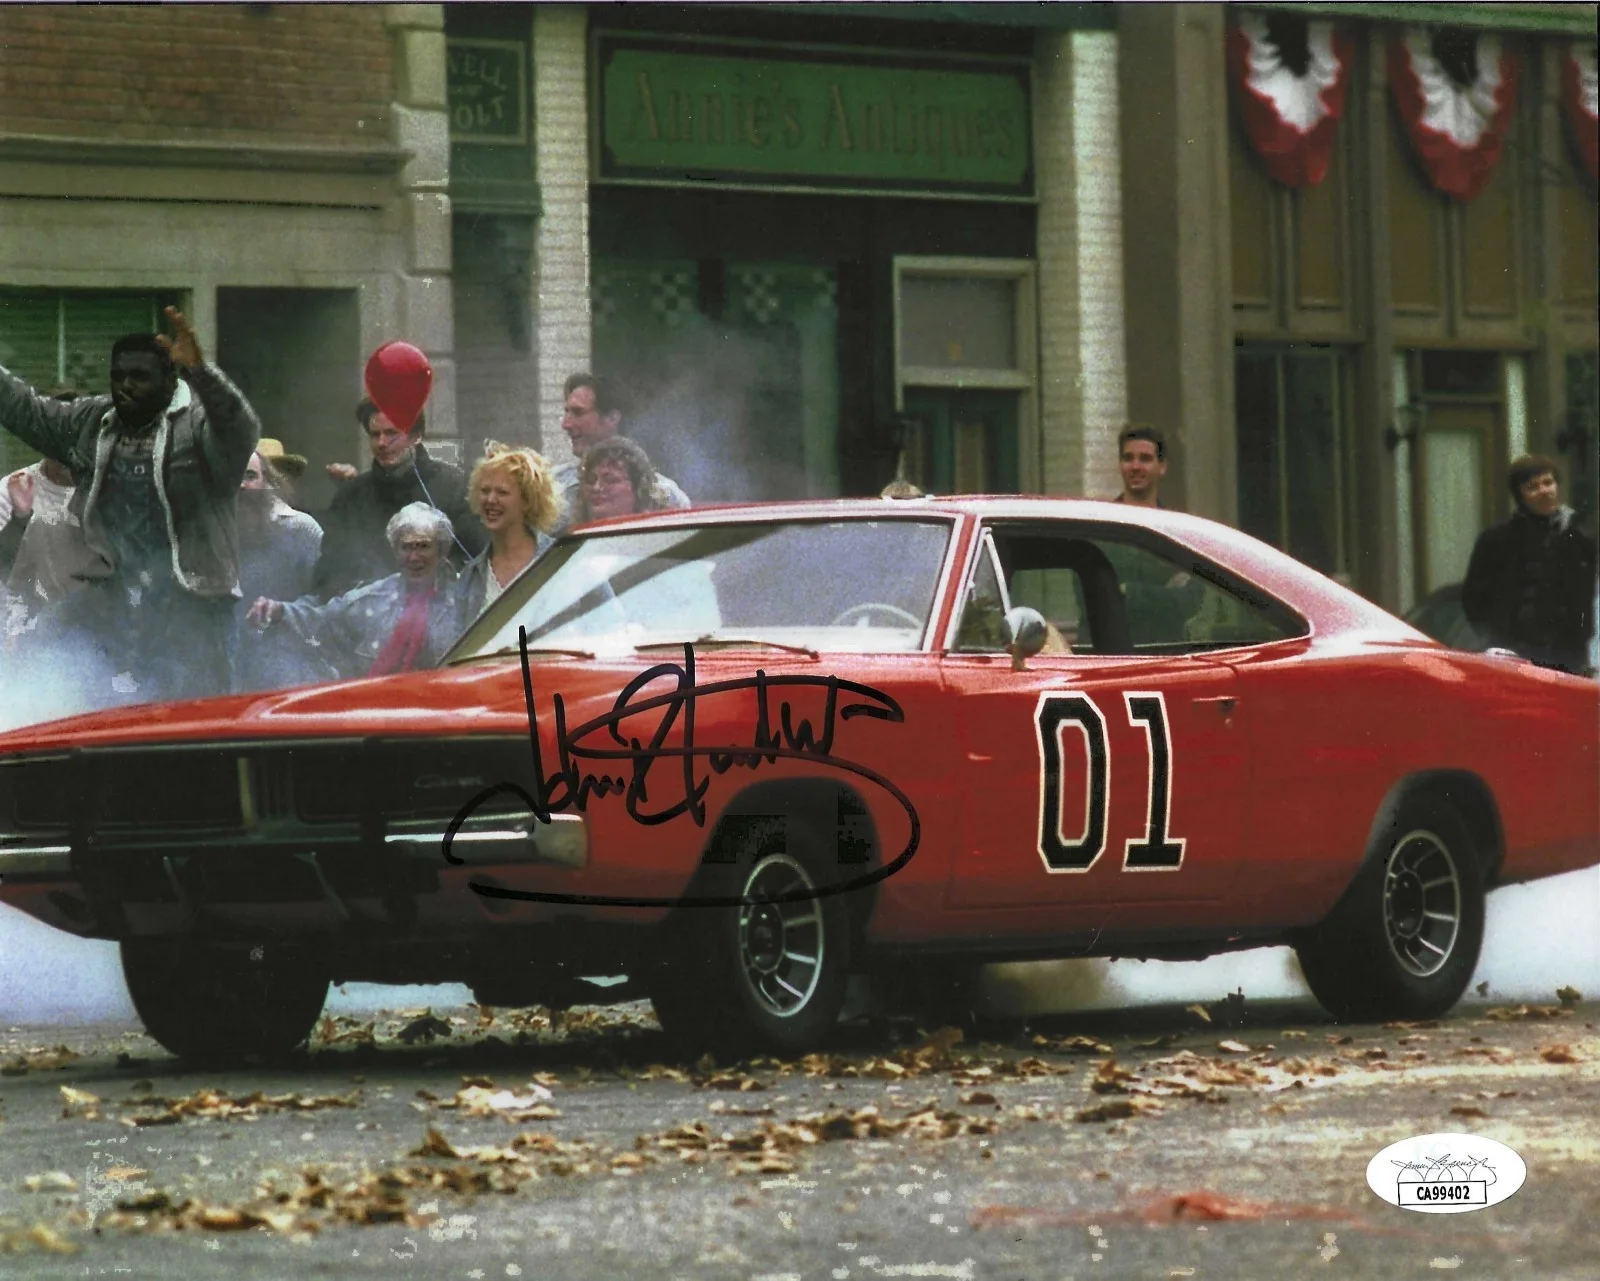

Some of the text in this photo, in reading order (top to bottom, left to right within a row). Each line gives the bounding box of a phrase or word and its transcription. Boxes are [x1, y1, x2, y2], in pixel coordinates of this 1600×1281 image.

[625, 70, 1015, 171] Annie's Antiques
[1034, 691, 1187, 873] 01
[1416, 1185, 1470, 1200] CA99402
